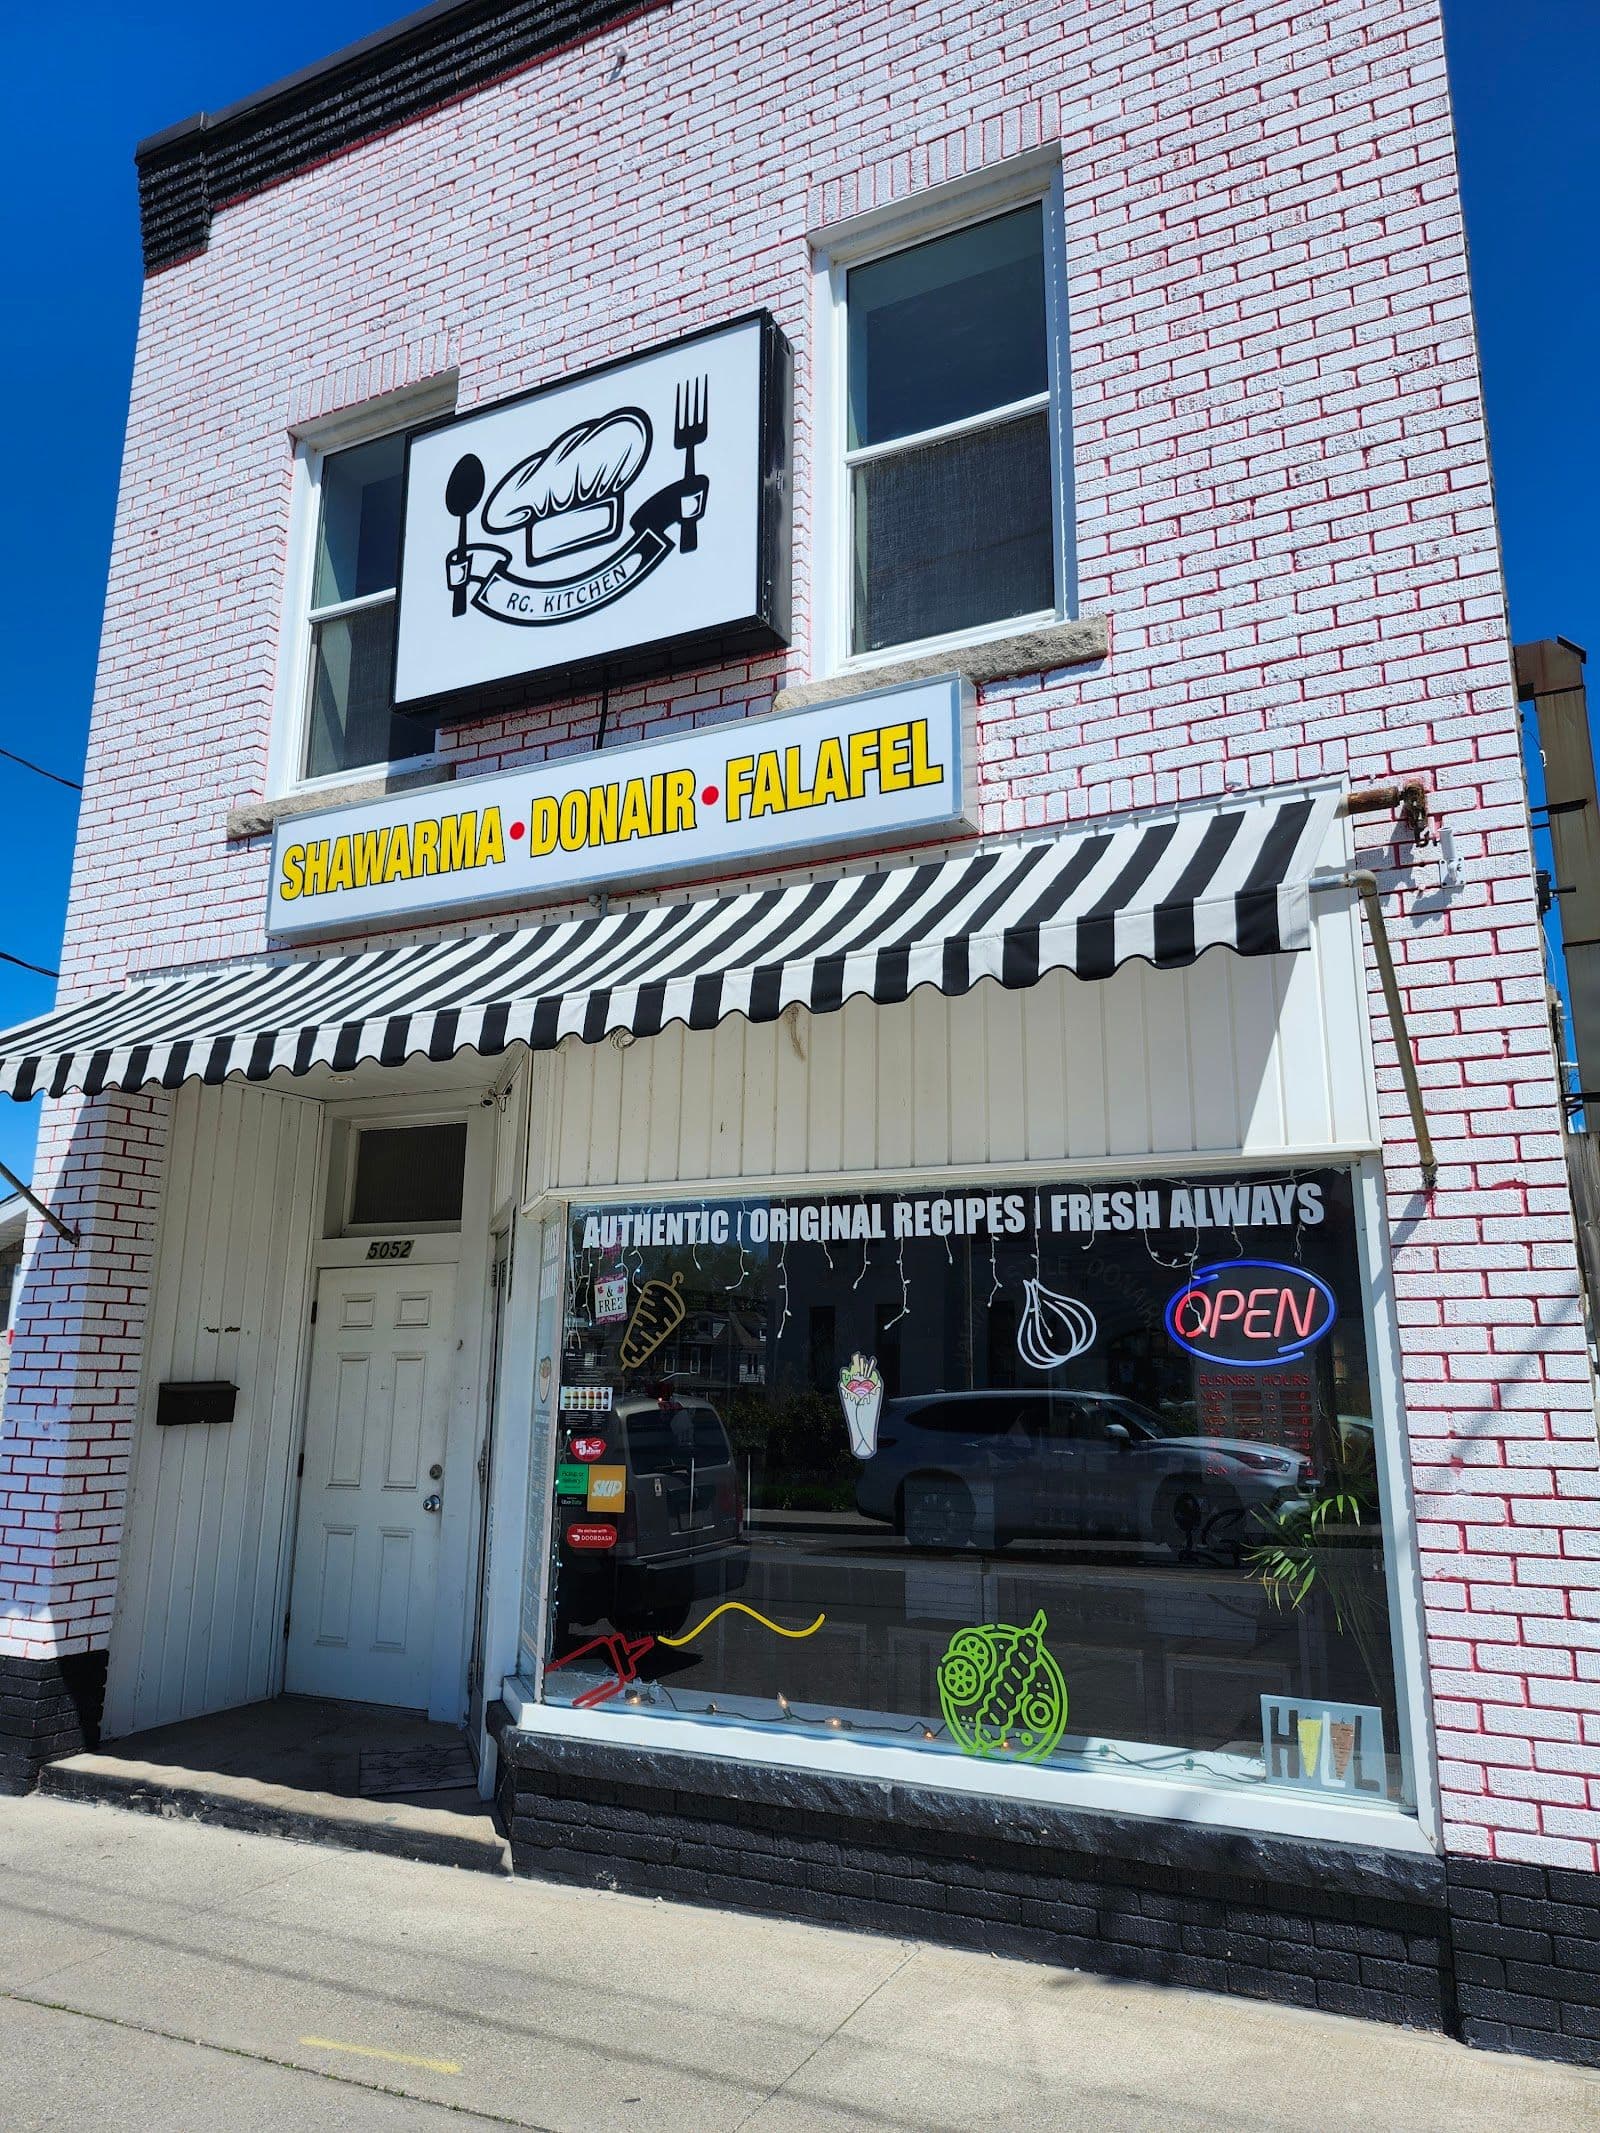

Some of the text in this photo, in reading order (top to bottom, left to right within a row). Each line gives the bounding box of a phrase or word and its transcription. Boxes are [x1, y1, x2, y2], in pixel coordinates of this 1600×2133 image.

[543, 564, 628, 613] KITCHEN
[279, 718, 945, 901] SHAWARMA DONAIR FALAFEL
[583, 1210, 729, 1249] AUTHENTIC
[749, 1203, 886, 1243] ORIGINAL
[893, 1195, 1026, 1239] RECIPES
[1050, 1189, 1160, 1233] FRESH
[1169, 1183, 1325, 1228] ALWAYS
[367, 1241, 412, 1258] 5052
[598, 1297, 623, 1313] FREE
[1173, 1288, 1317, 1340] OPEN
[1199, 1372, 1311, 1387] BUSINESS HOURS
